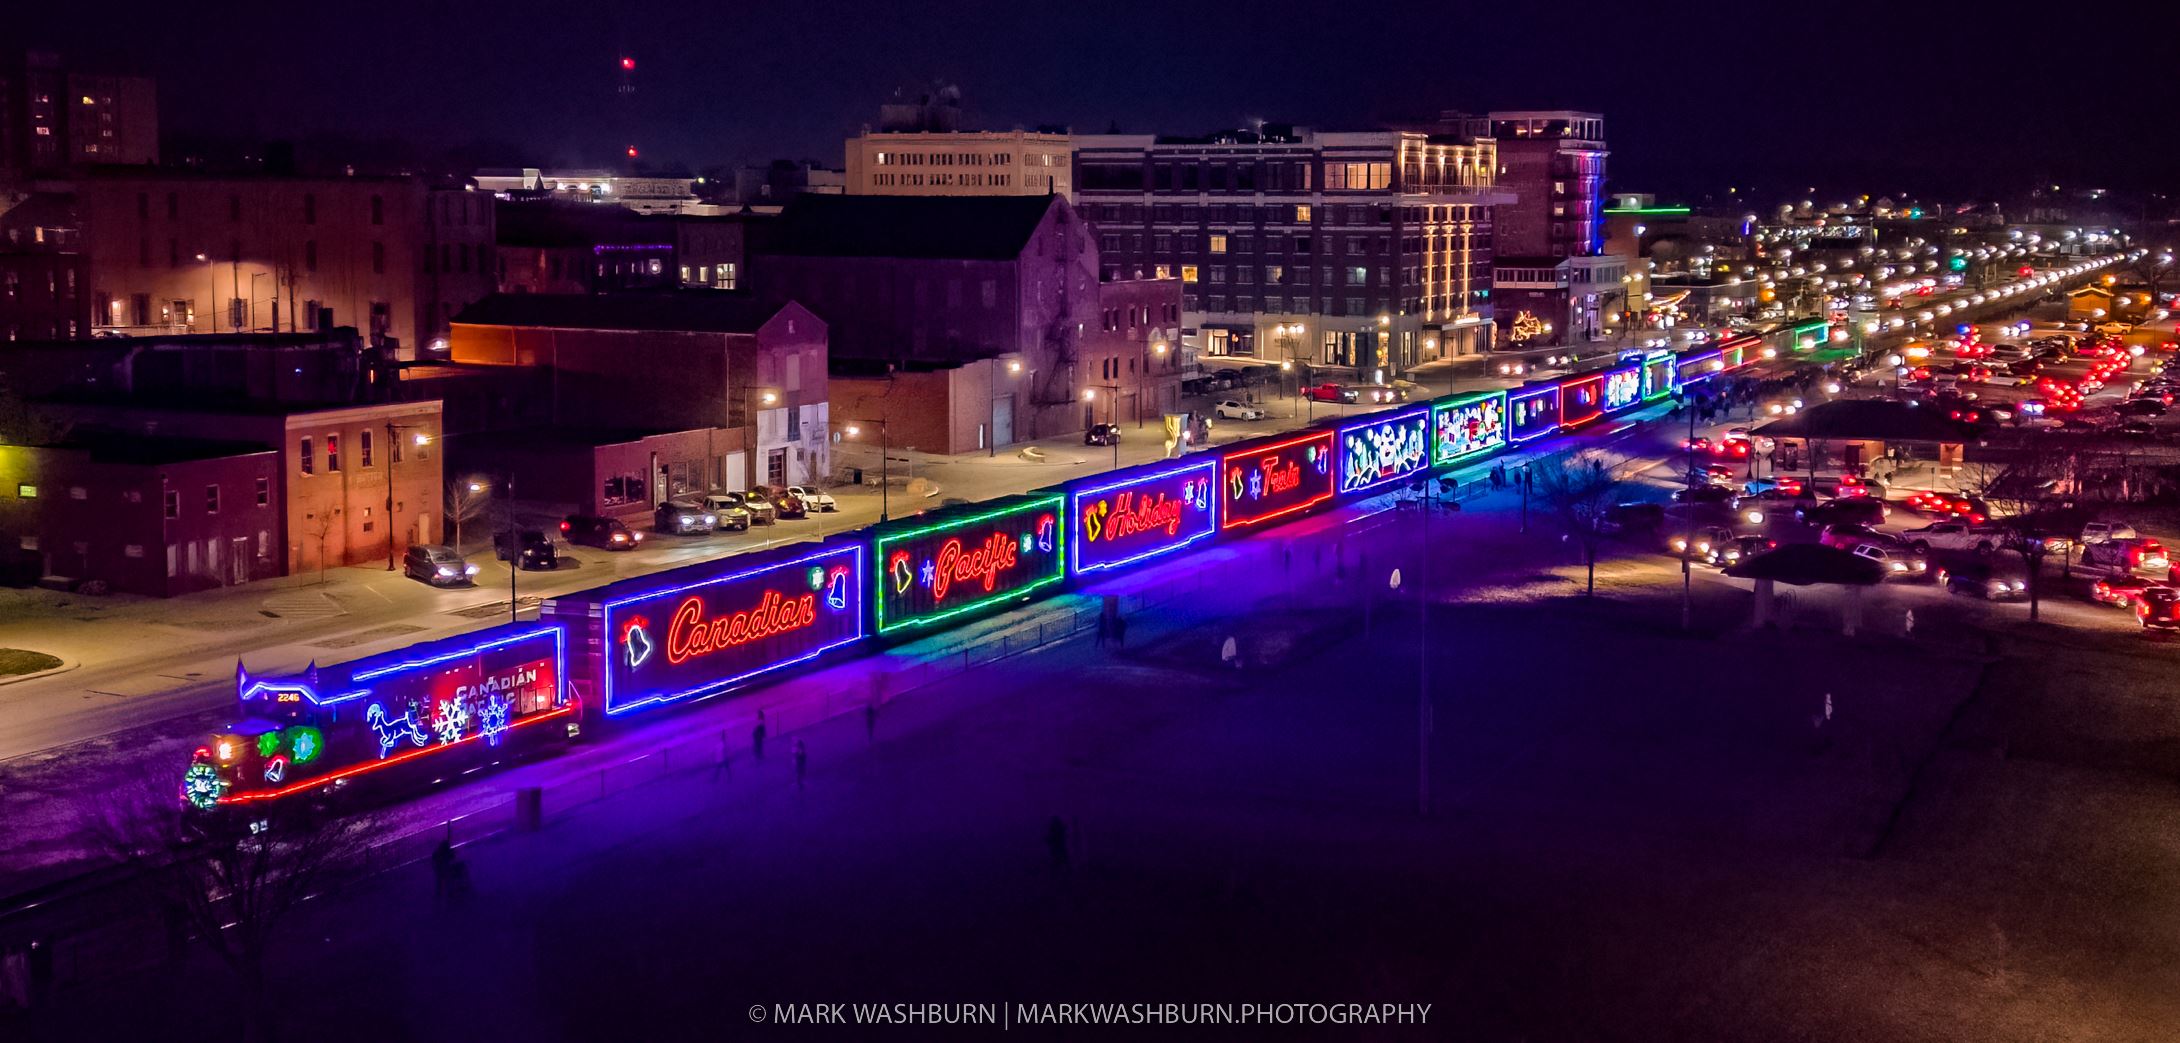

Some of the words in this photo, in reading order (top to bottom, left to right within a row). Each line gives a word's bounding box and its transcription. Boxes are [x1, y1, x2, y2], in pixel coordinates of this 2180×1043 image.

[1263, 456, 1299, 496] Train
[1105, 491, 1182, 541] Holiday
[933, 533, 1017, 599] Pacific
[667, 591, 814, 664] Canadian
[277, 693, 300, 703] 2246
[456, 669, 537, 701] CANADIAN
